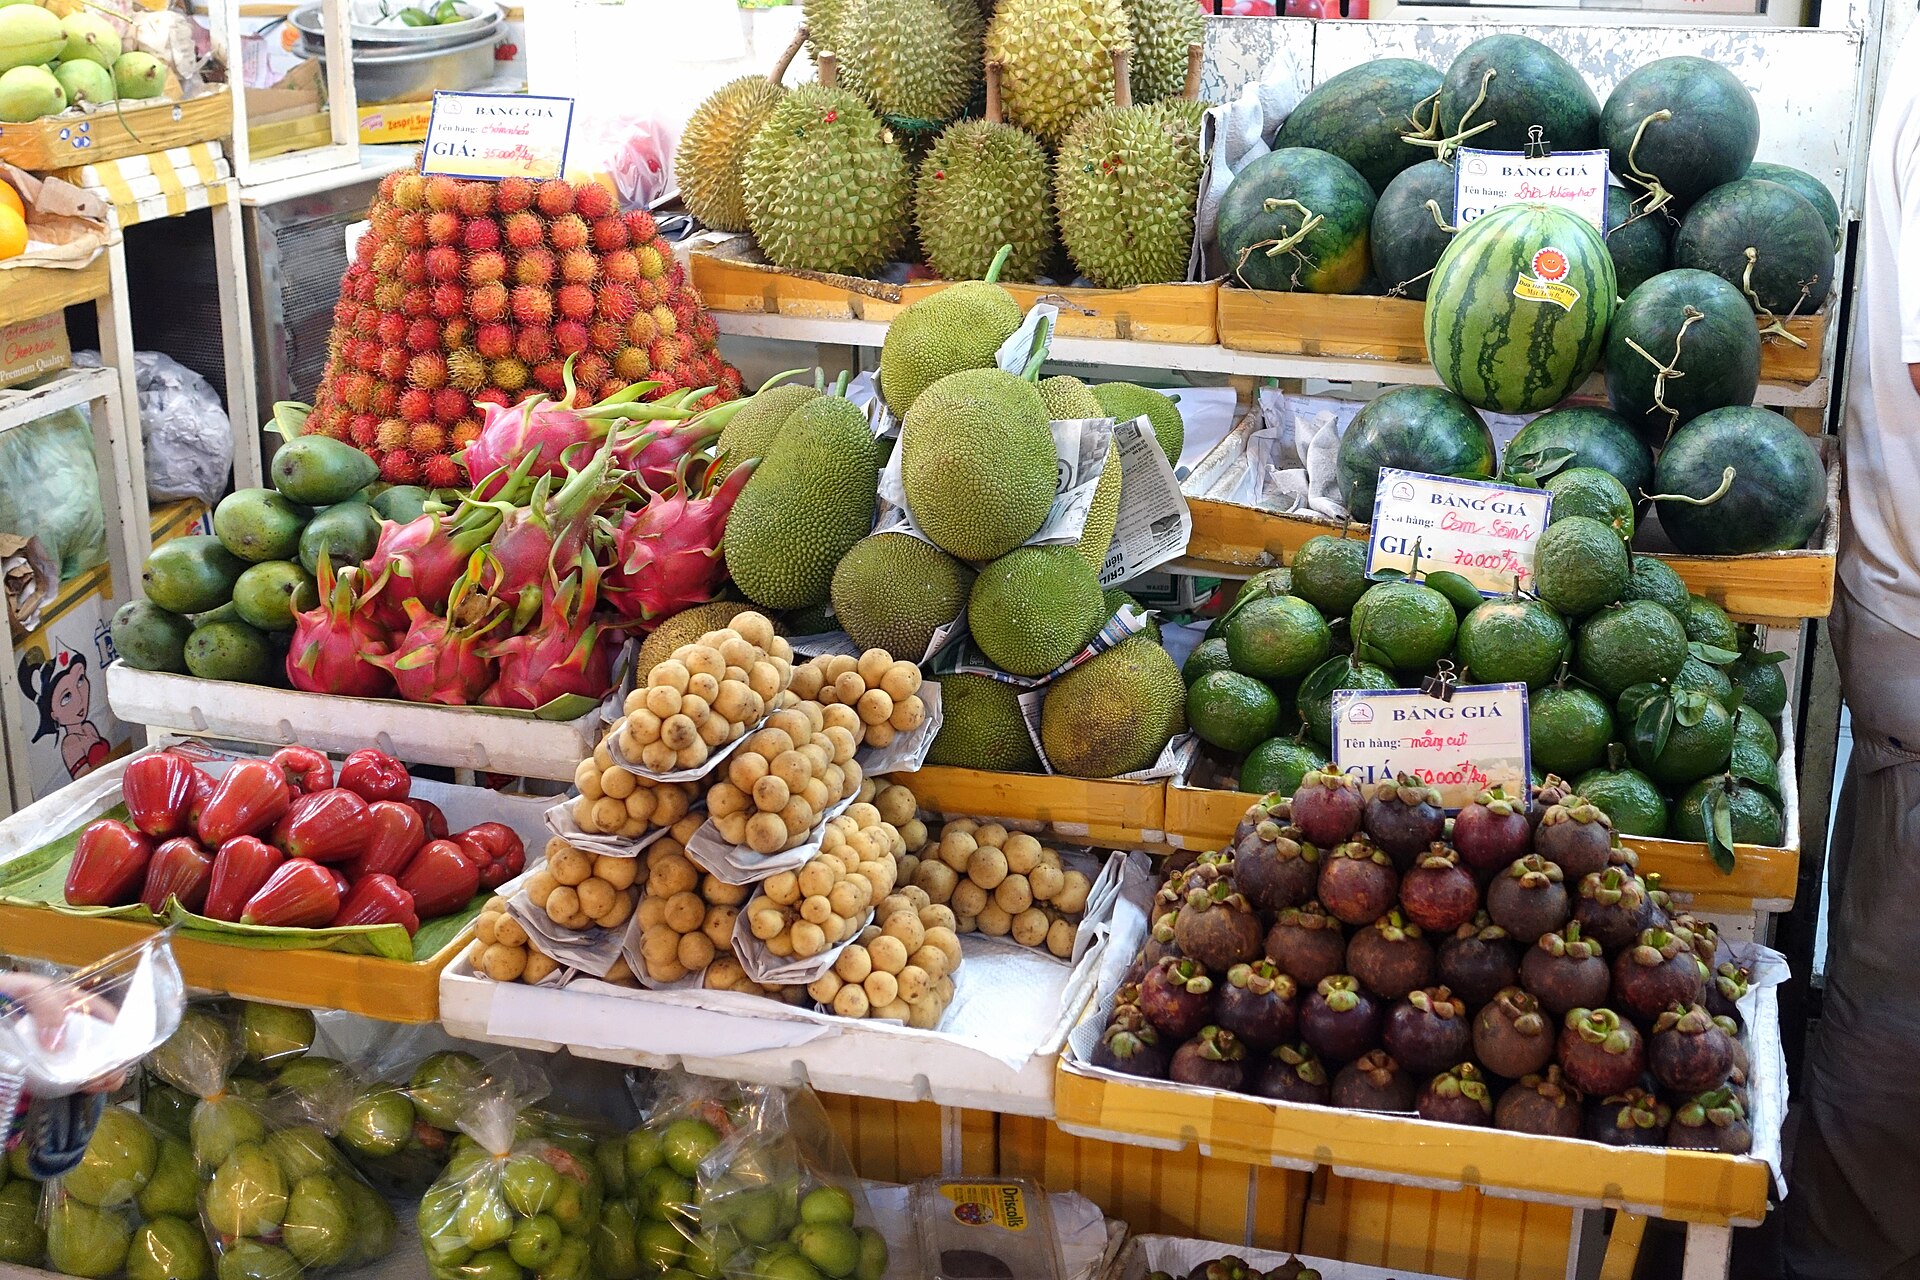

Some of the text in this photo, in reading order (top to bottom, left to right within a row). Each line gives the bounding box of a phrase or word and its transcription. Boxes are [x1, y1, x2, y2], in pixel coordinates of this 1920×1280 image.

[433, 139, 477, 158] GIÁ:
[1502, 164, 1589, 177] BẢNG GIÁ
[1463, 185, 1480, 195] Tên
[1482, 186, 1508, 198] hàng:
[0, 354, 65, 381] Premium Quality
[1430, 492, 1528, 517] BẢNG GIÁ
[1406, 515, 1434, 529] hàng:
[1098, 565, 1125, 585] CRIL
[1392, 702, 1503, 722] BẢNG GIÁ
[1343, 737, 1365, 749] Tên
[1368, 736, 1401, 750] hàng:
[1002, 1187, 1024, 1228] Driscoll's
